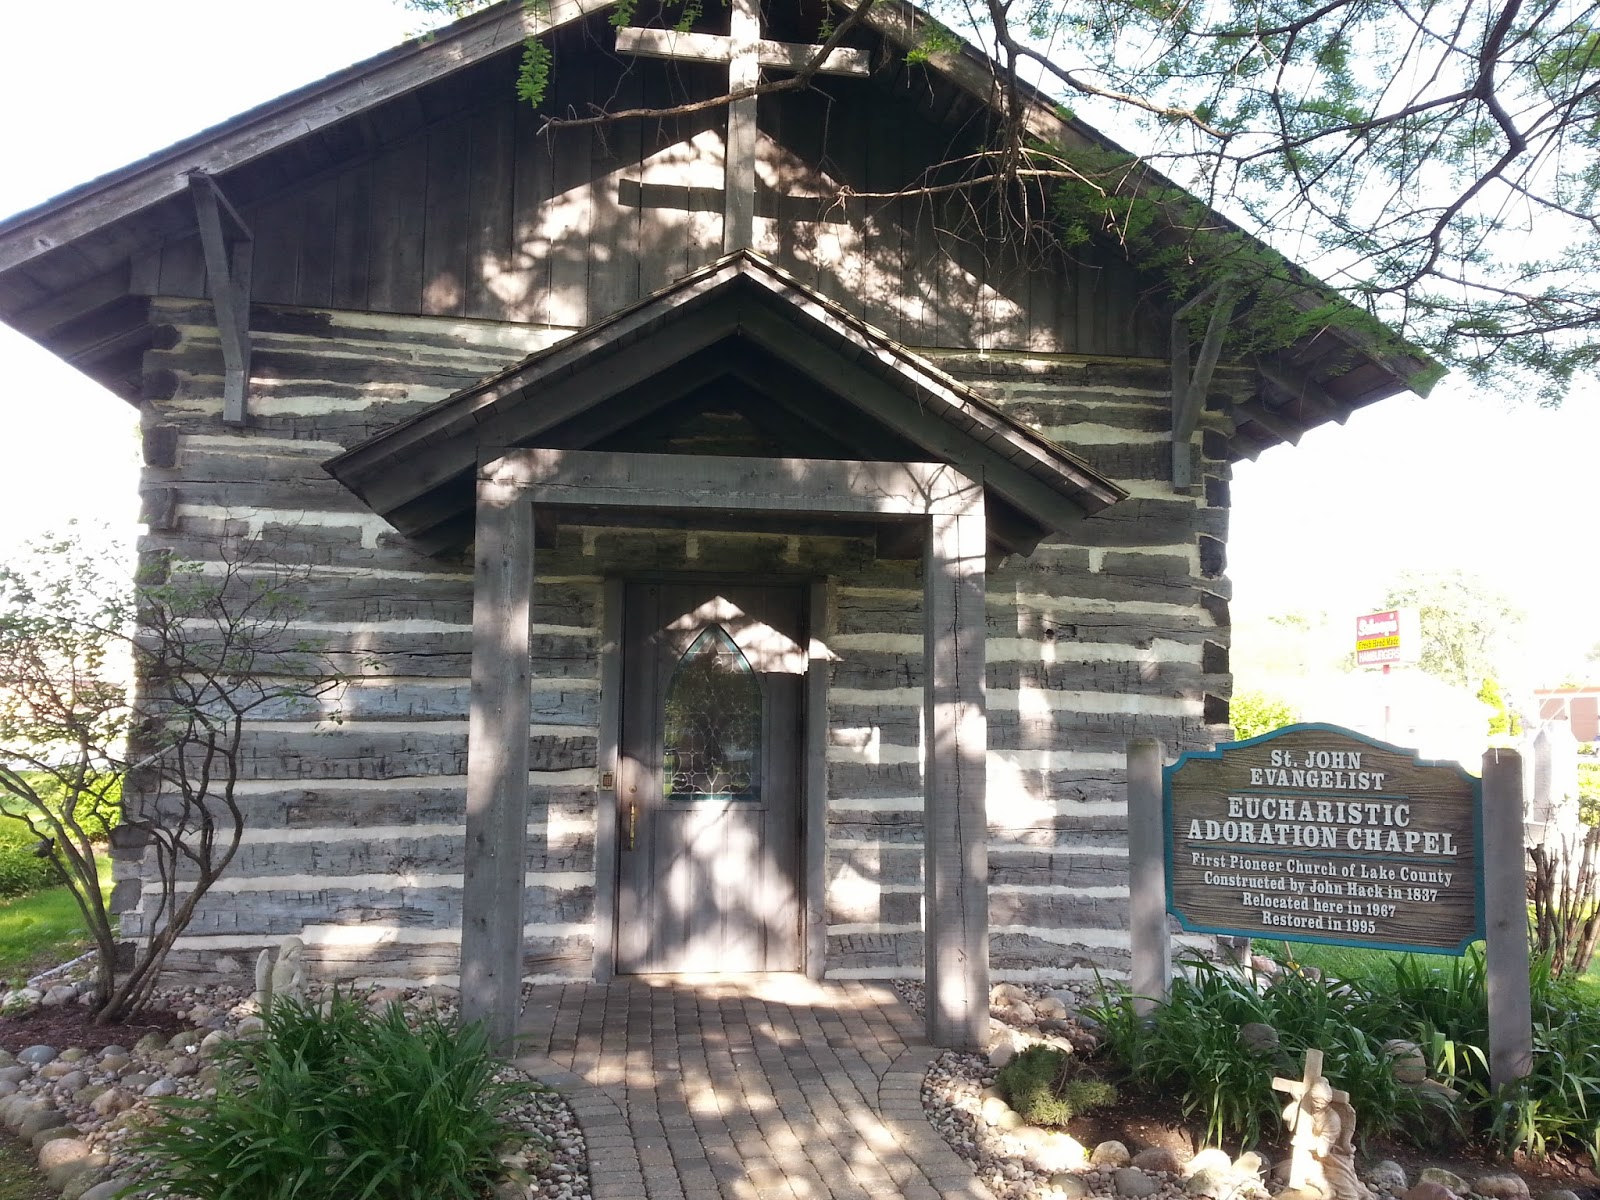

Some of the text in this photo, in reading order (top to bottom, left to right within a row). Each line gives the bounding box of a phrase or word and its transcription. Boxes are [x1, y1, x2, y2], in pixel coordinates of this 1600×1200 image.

[1270, 749, 1362, 770] St. JOHN
[1250, 768, 1385, 791] EVANGELIST
[1227, 797, 1411, 827] EUCHARISTIC
[1187, 819, 1458, 855] ADORATION CHAPEL
[1191, 852, 1453, 887] First Pioneer Church of Lake County
[1204, 871, 1438, 902] Constructed by John Hack in 1837
[1242, 892, 1396, 918] Relocated here in 1967
[1262, 911, 1377, 934] Restored in 1995
